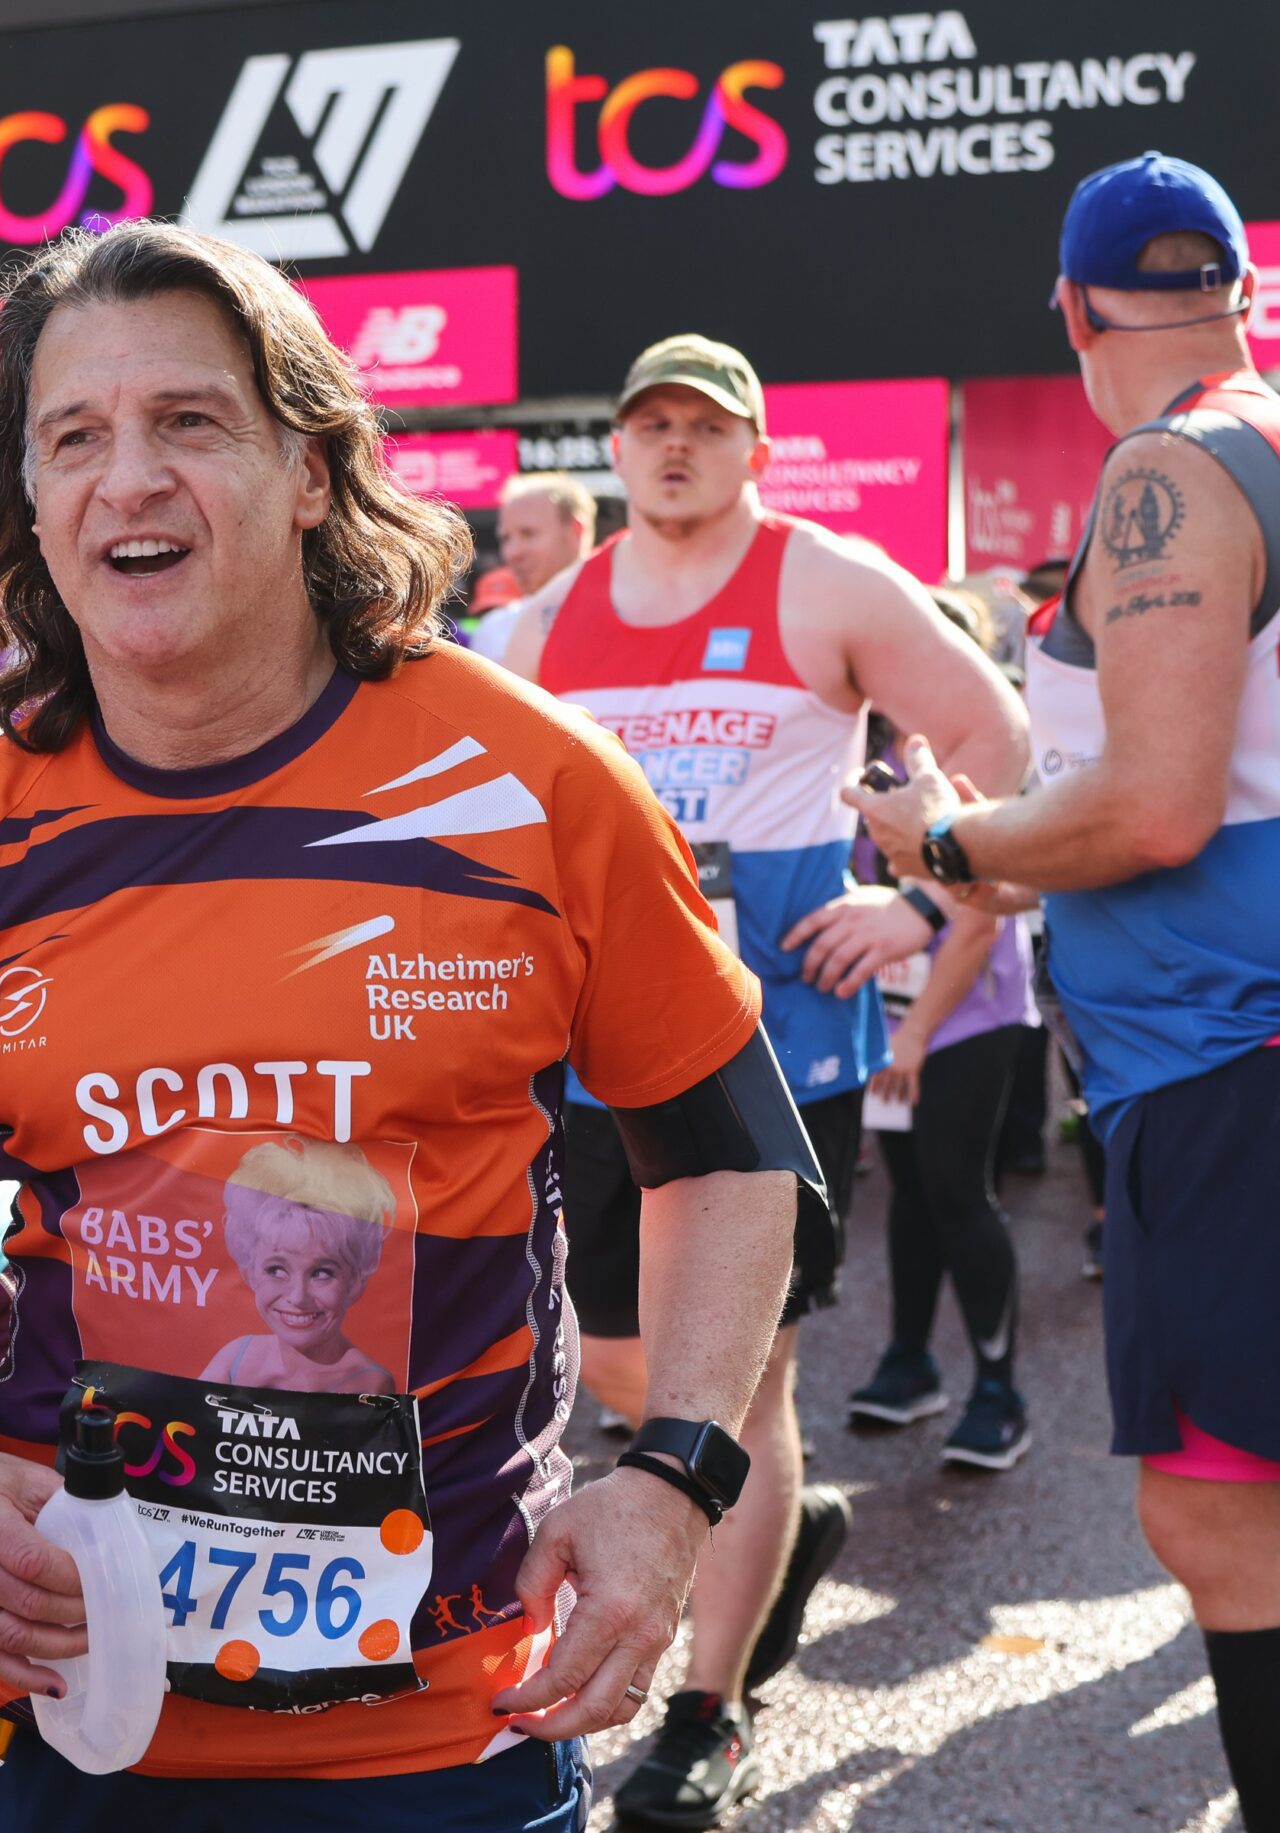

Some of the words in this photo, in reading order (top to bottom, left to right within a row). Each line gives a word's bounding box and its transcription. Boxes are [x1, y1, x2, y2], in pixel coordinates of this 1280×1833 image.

[815, 11, 977, 69] TATA
[815, 52, 1197, 127] CONSULTANCY
[545, 45, 789, 201] tcs
[815, 121, 1055, 186] SERVICES
[642, 750, 747, 784] NCER
[365, 952, 535, 982] Alzheimer's
[367, 983, 508, 1011] Research
[369, 1014, 417, 1041] UK
[75, 1060, 372, 1155] SCOTT
[80, 1207, 213, 1261] BABS'
[84, 1249, 219, 1308] ARMY
[217, 1410, 301, 1441] TATA
[214, 1440, 410, 1475] CONSULTANCY
[213, 1470, 337, 1504] SERVICES
[181, 1514, 286, 1537] #WeRunTogether
